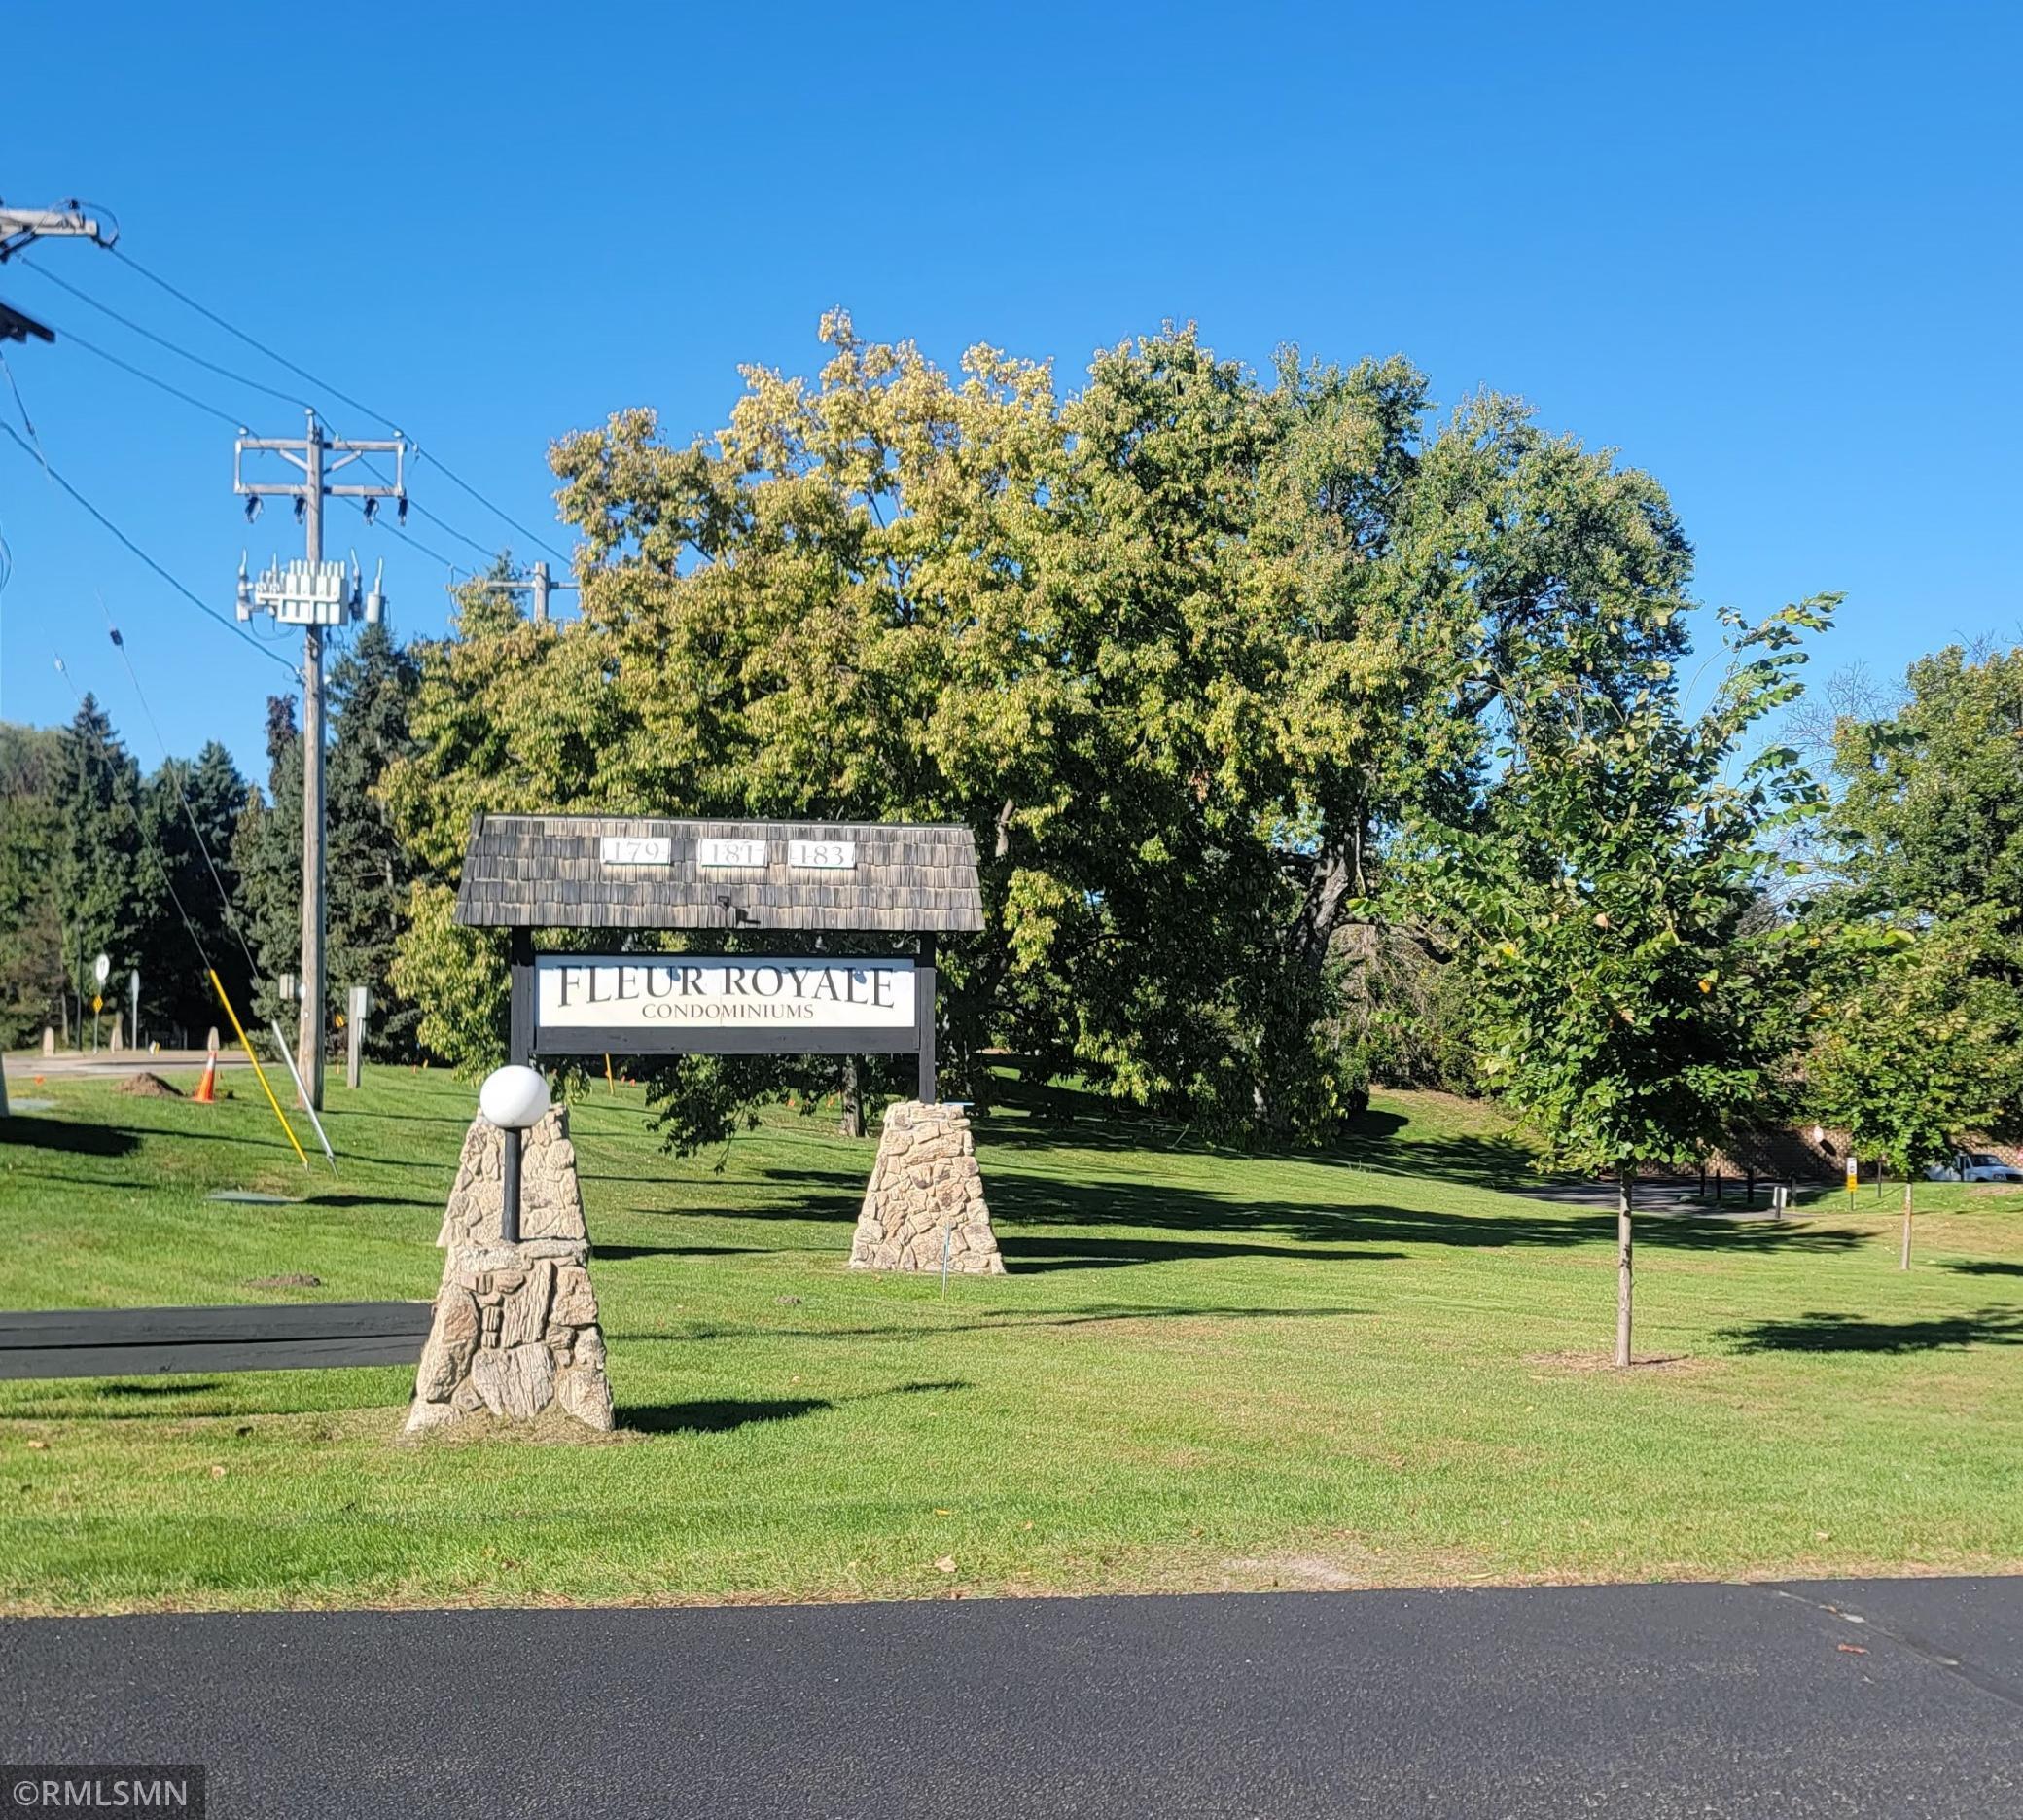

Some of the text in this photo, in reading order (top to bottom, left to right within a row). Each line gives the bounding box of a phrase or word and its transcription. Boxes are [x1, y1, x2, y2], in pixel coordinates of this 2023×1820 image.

[614, 841, 660, 861] 179
[711, 842, 754, 865] 181
[800, 844, 844, 866] 183
[556, 964, 895, 1009] FLEUR ROYALE
[641, 1003, 814, 1019] CONDOMINIUMS
